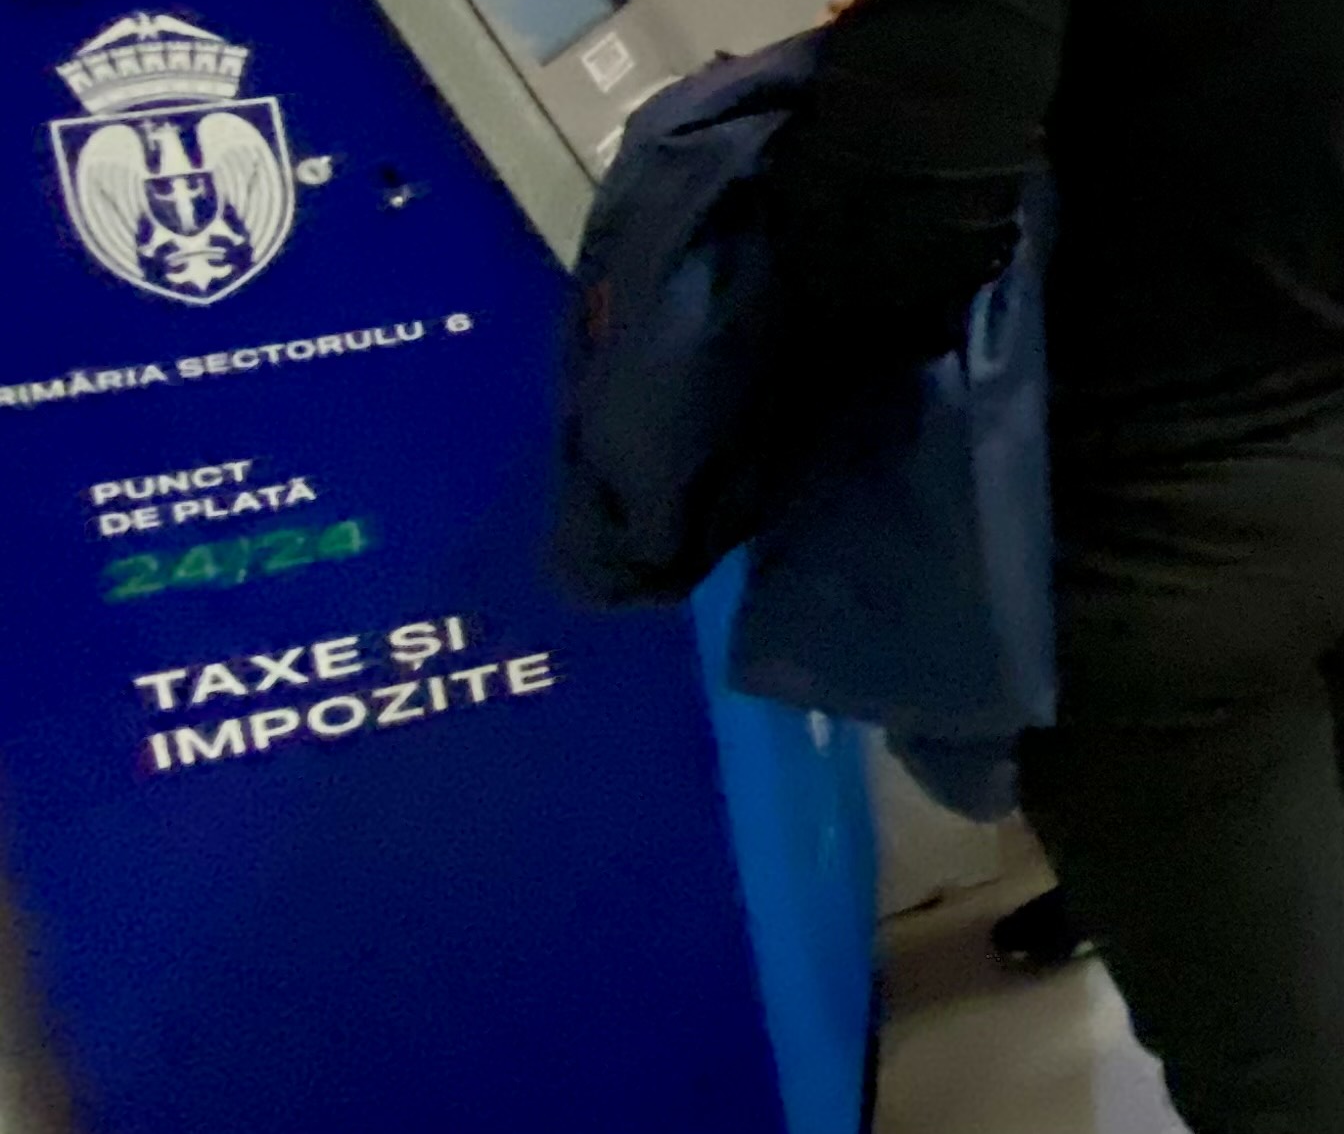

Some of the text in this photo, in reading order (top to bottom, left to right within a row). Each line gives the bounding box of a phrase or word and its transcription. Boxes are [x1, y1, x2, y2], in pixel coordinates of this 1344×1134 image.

[446, 312, 473, 333] 6
[90, 459, 253, 506] PUNCT
[99, 475, 317, 537] DE PLATĂ
[103, 519, 367, 603] 24/24
[133, 616, 465, 712] TAXE ȘI
[148, 652, 557, 771] IMPOZITE
